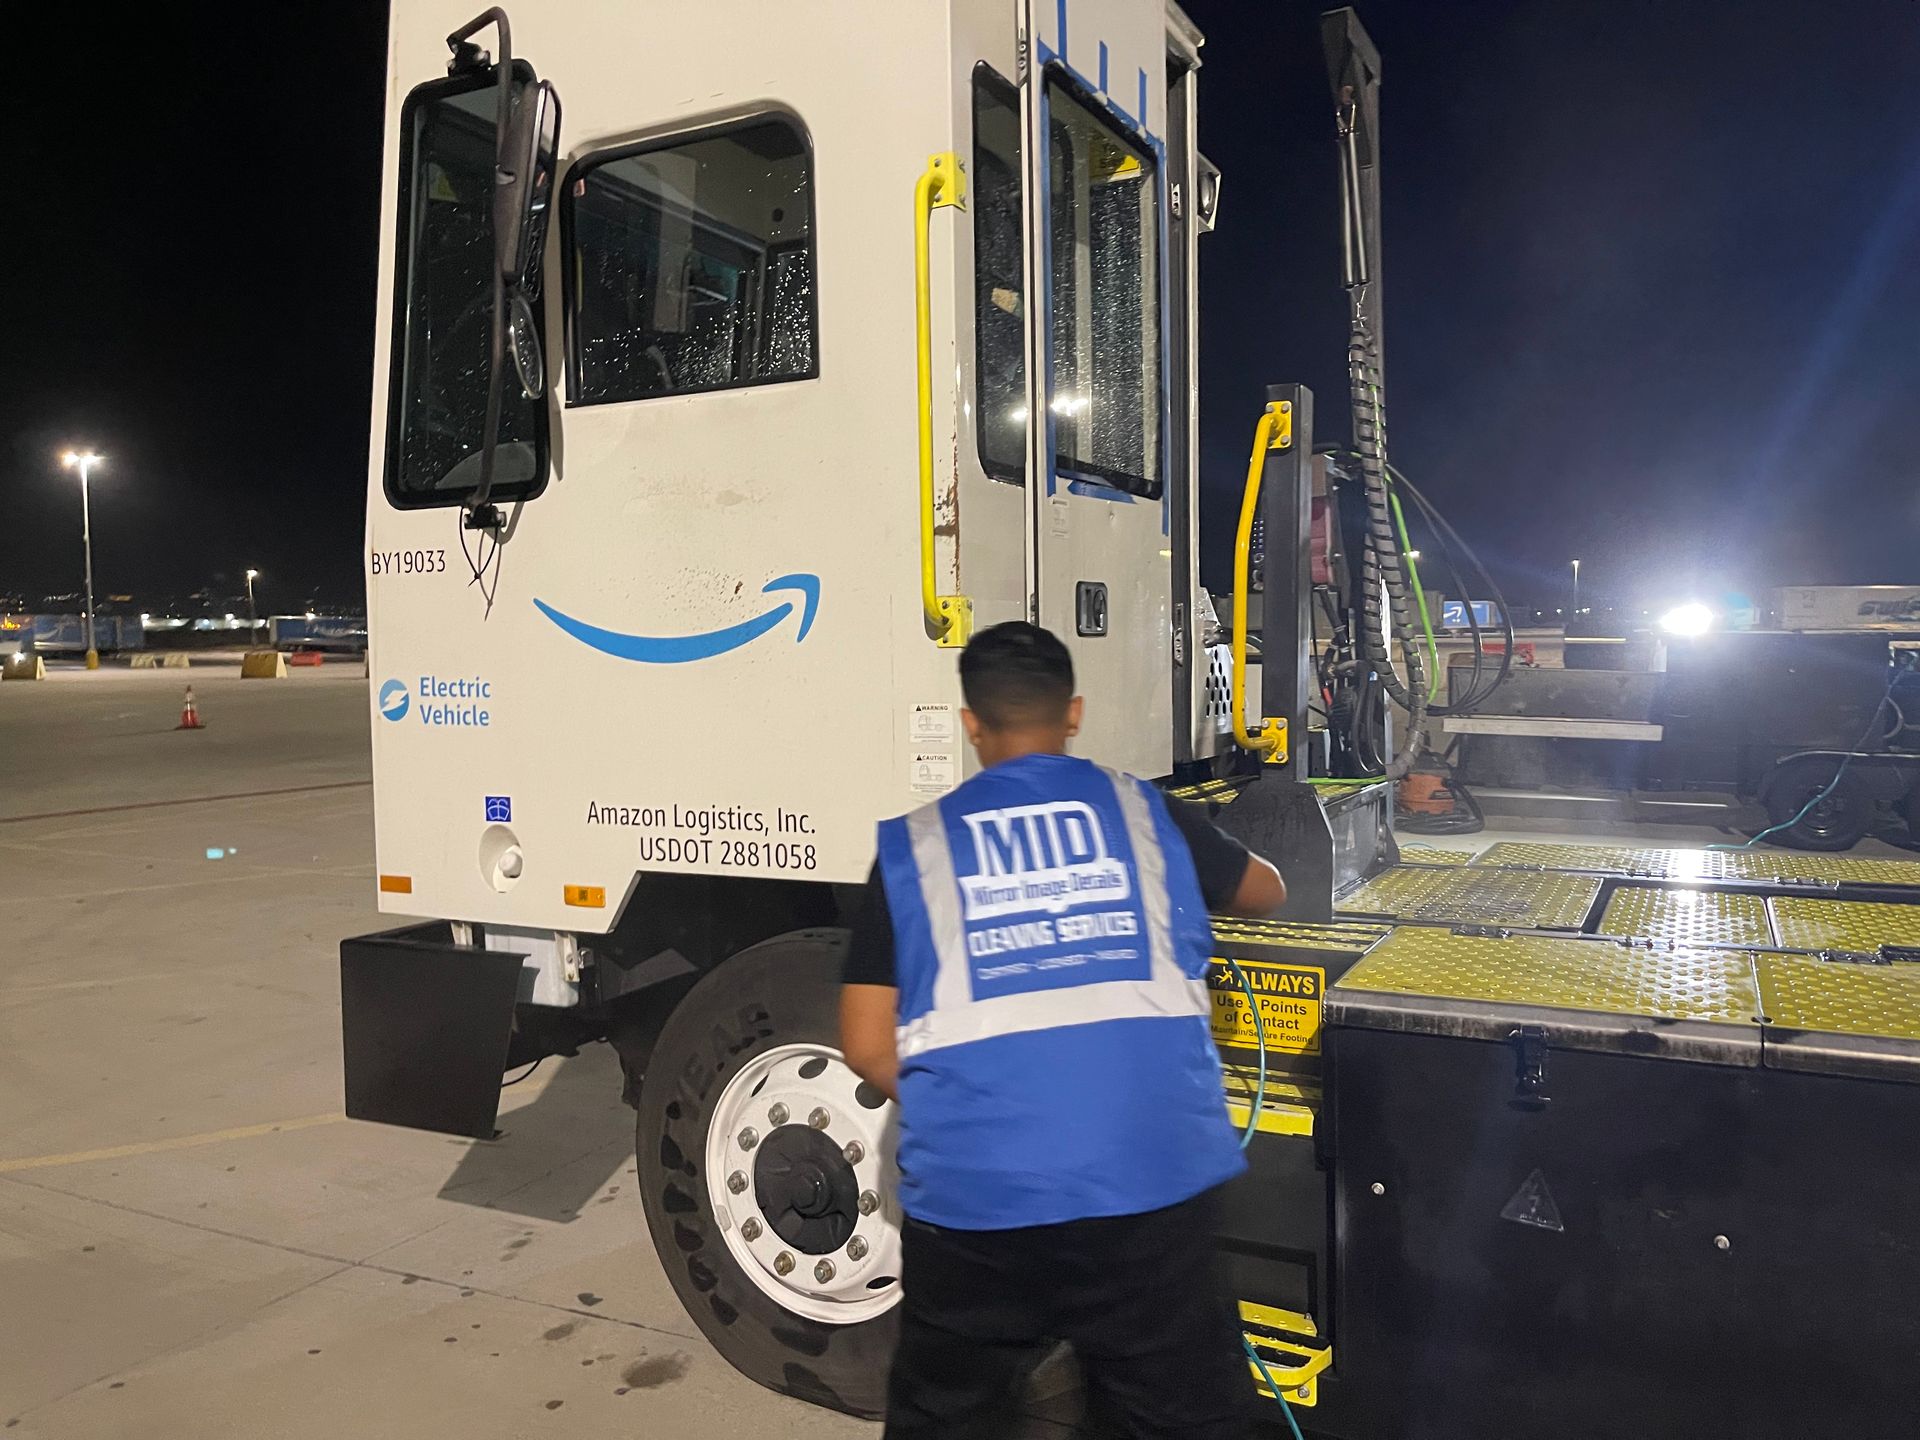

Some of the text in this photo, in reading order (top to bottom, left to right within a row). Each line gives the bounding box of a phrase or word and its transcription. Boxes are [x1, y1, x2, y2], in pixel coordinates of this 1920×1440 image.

[372, 550, 446, 575] BY19033
[420, 675, 491, 698] Electric
[419, 703, 490, 727] Vehicle
[587, 800, 816, 837] Amazon Logistics, Inc.
[640, 836, 817, 870] USDOT 2881058
[973, 810, 1098, 877] MID
[1216, 994, 1243, 1009] Use
[1261, 999, 1307, 1015] Points
[1224, 1011, 1299, 1030] of Cntact
[1279, 1032, 1313, 1045] Footing
